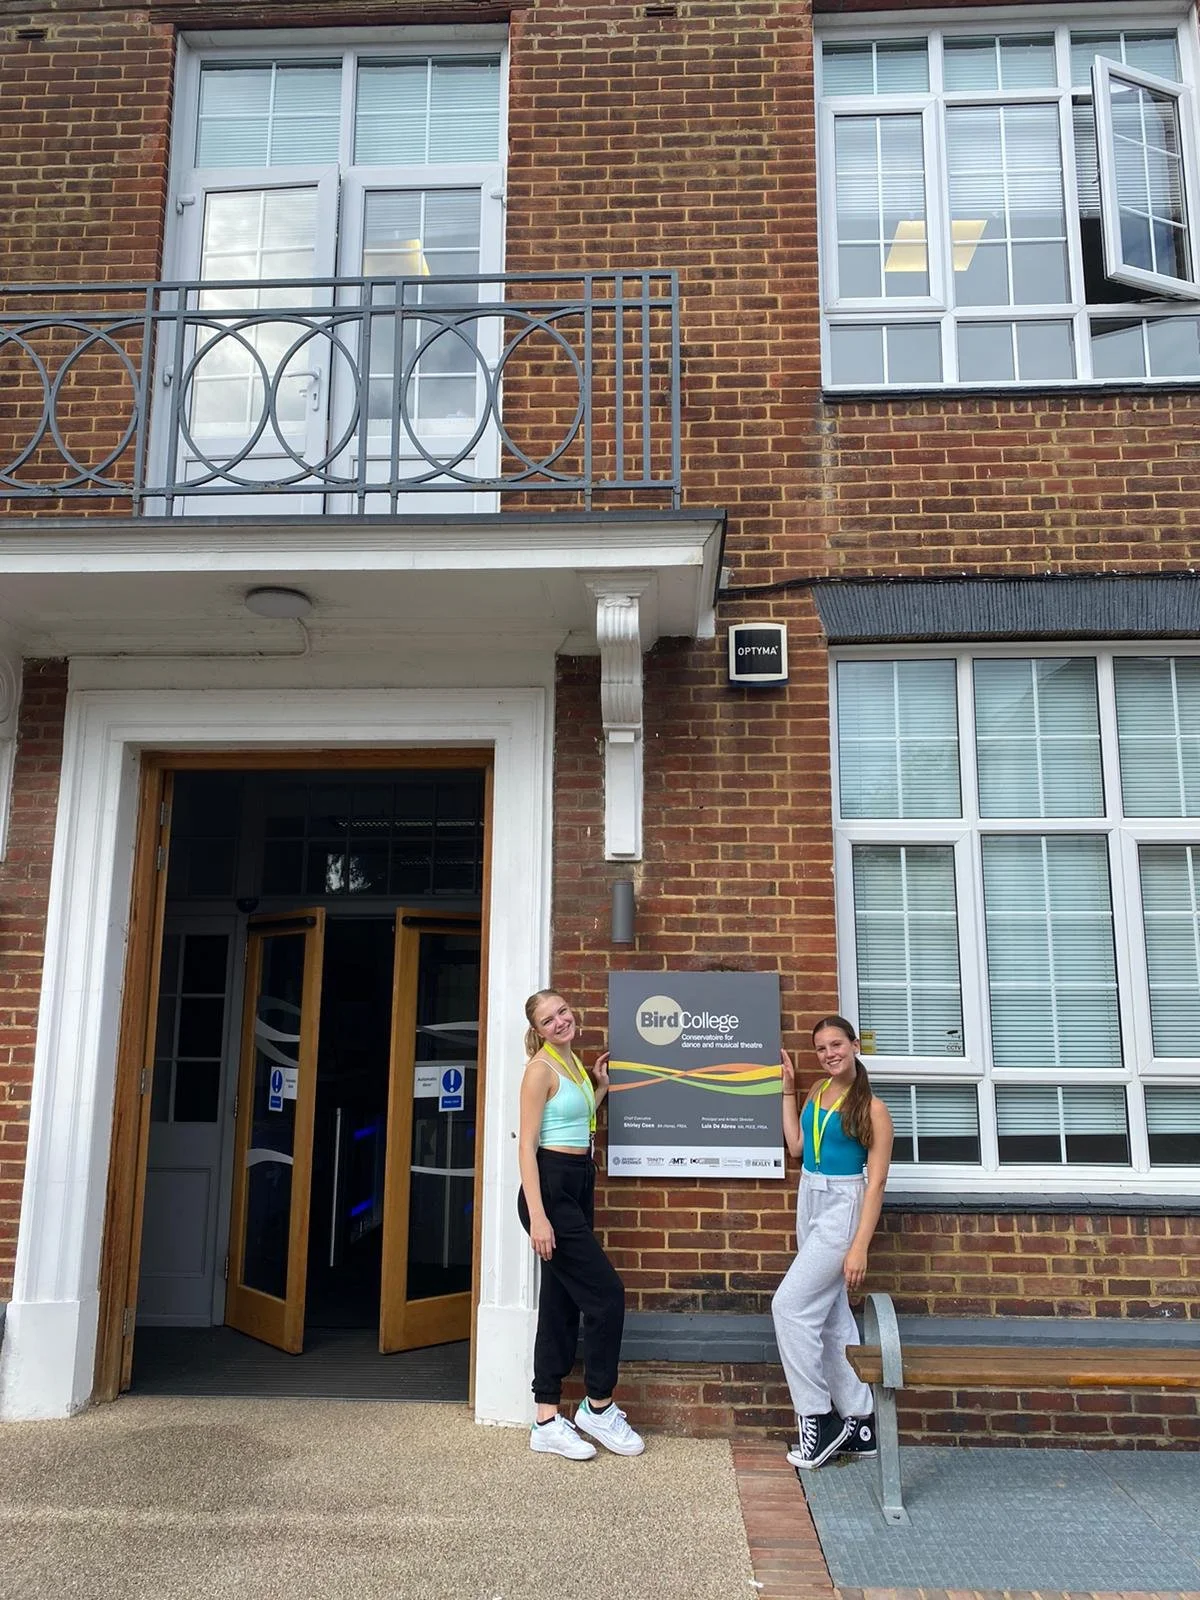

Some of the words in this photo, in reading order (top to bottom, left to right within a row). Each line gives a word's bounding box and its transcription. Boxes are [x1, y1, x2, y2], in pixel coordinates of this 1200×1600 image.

[737, 646, 778, 656] OPTYMA
[681, 1033, 723, 1041] Conservatoire
[724, 1033, 734, 1041] for
[681, 1041, 701, 1049] dance
[702, 1041, 714, 1049] and
[715, 1041, 740, 1049] musical
[740, 1041, 763, 1049] theatre
